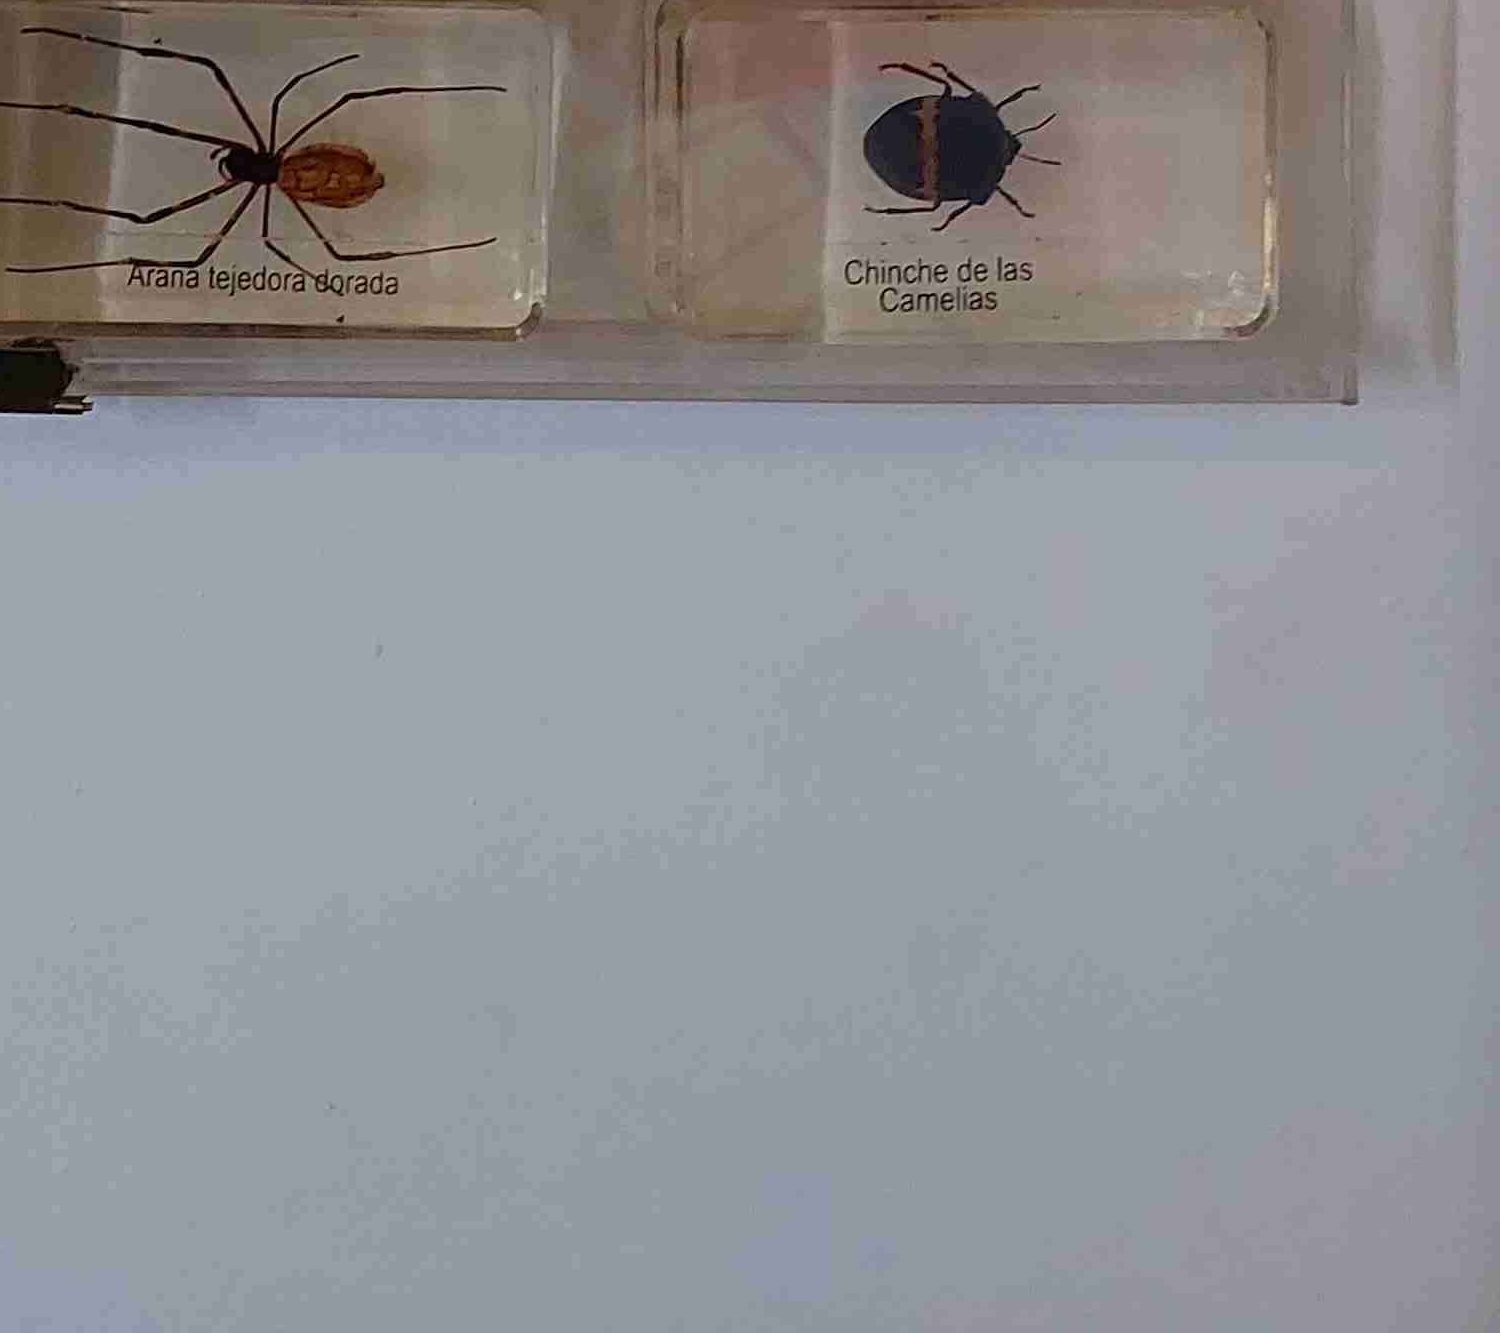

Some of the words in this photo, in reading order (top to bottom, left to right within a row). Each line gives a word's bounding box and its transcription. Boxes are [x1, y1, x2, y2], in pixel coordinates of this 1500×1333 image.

[209, 264, 306, 296] tejedora
[315, 268, 399, 295] dorada
[844, 258, 948, 285] Chinche
[957, 257, 988, 282] de
[996, 257, 1033, 281] las
